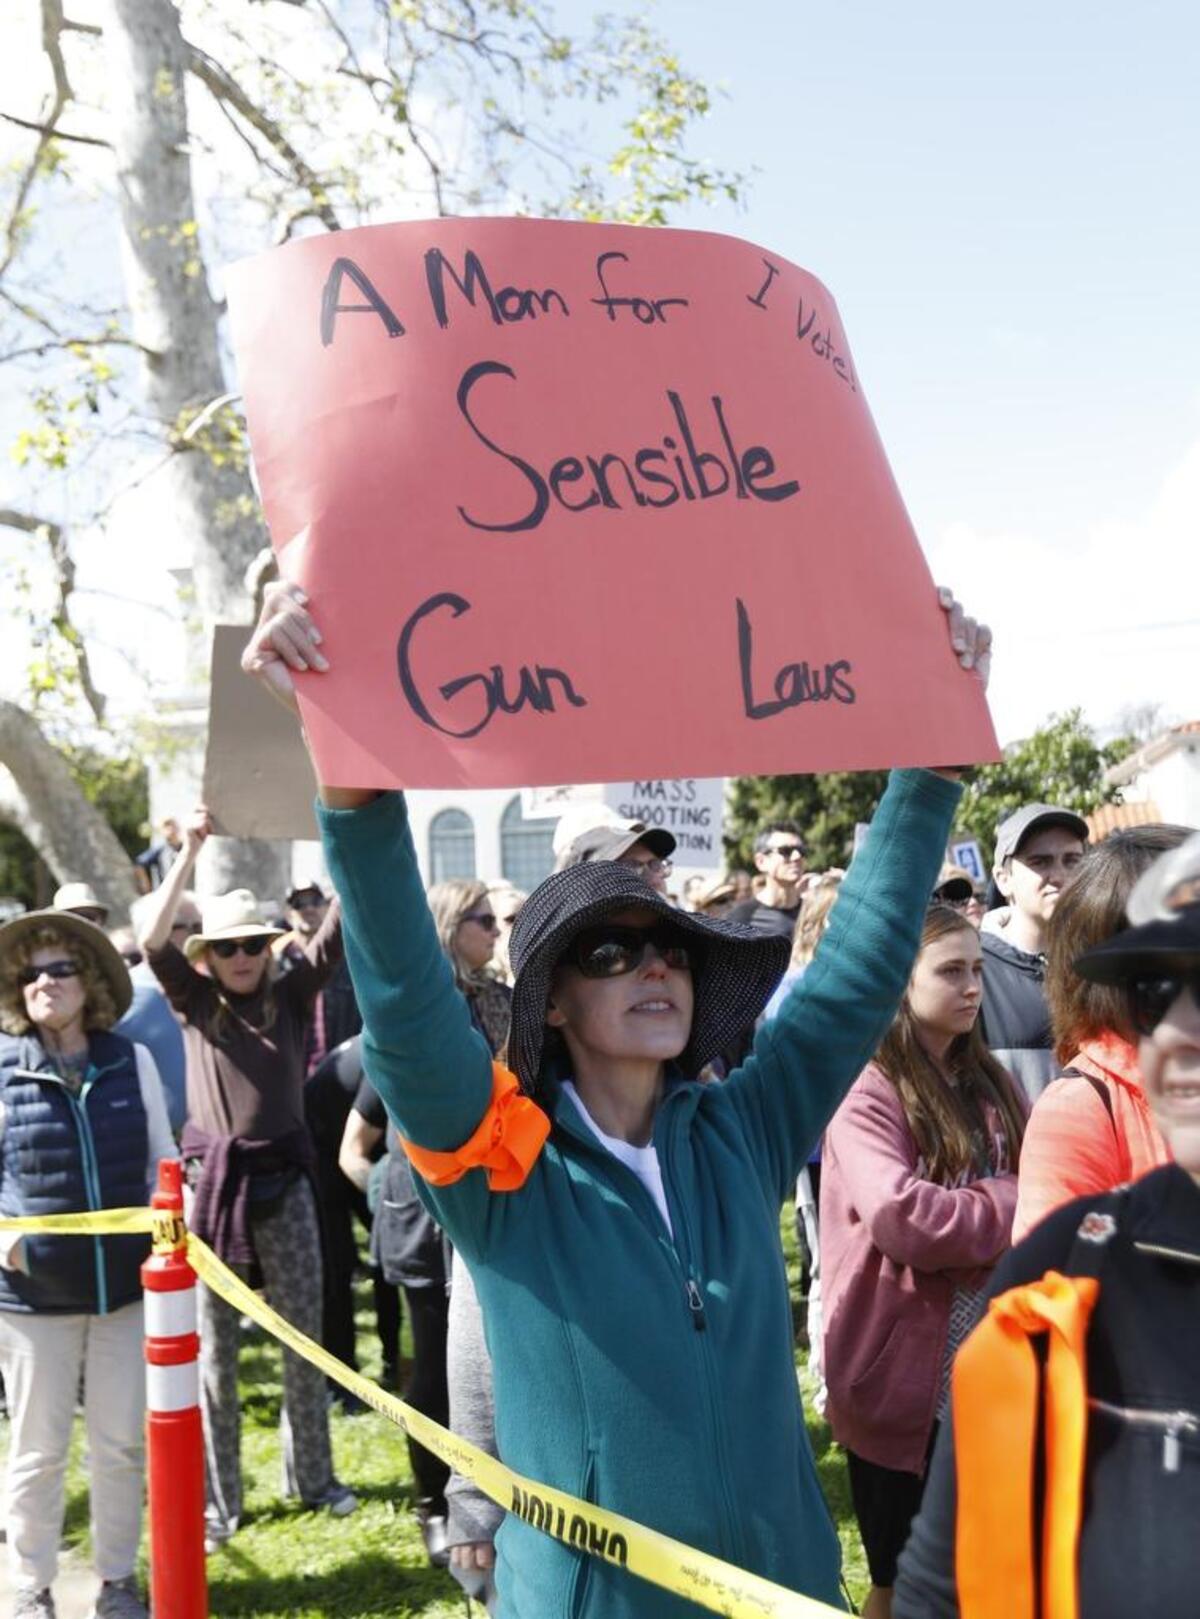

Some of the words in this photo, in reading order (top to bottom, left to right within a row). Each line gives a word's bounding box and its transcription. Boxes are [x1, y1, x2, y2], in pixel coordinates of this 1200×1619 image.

[320, 258, 405, 346] A
[424, 248, 571, 330] Mom
[746, 258, 780, 311] I
[456, 360, 801, 533] Sensible
[396, 591, 587, 739] Gun
[736, 598, 857, 721] Laws
[632, 780, 697, 802] MASS
